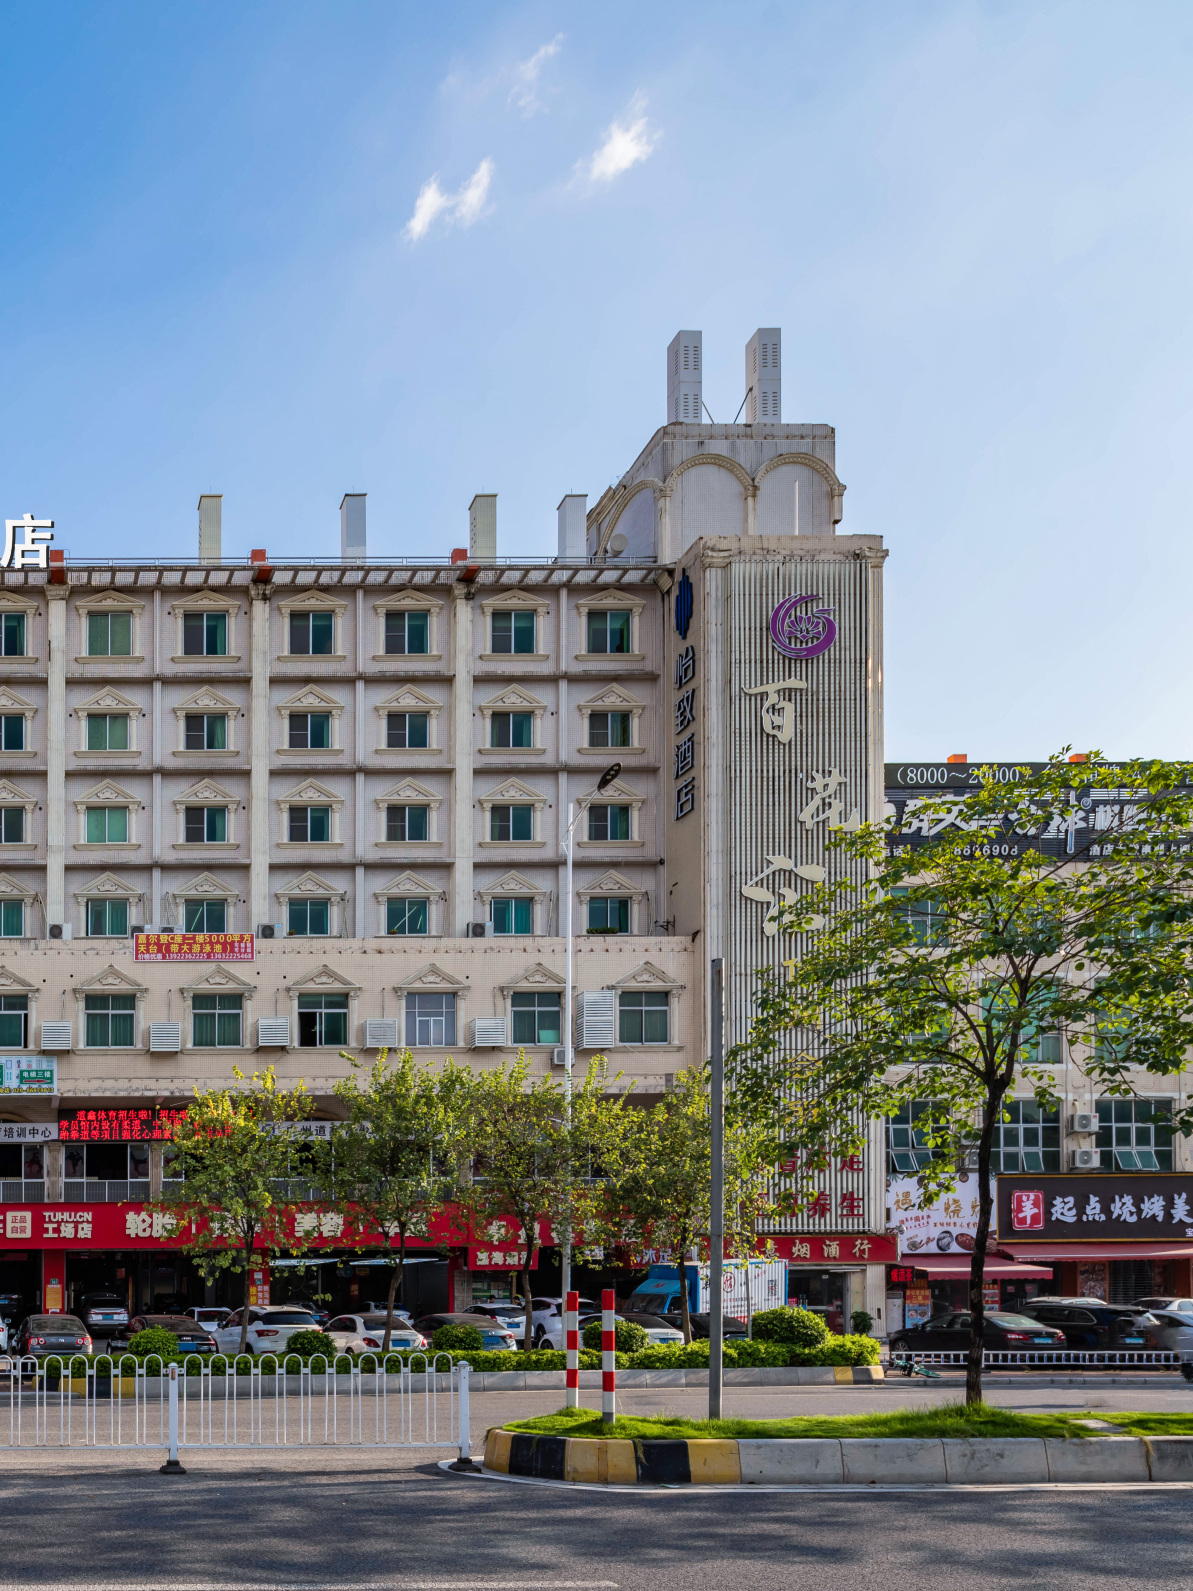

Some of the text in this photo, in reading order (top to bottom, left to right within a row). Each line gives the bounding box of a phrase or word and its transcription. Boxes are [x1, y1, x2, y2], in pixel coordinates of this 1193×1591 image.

[673, 644, 696, 821] 怡致酒店
[1051, 1191, 1193, 1224] 起点烧烤美
[10, 1215, 27, 1224] 正品
[43, 1212, 92, 1222] TUHU.CN
[43, 1223, 92, 1239] 工场店
